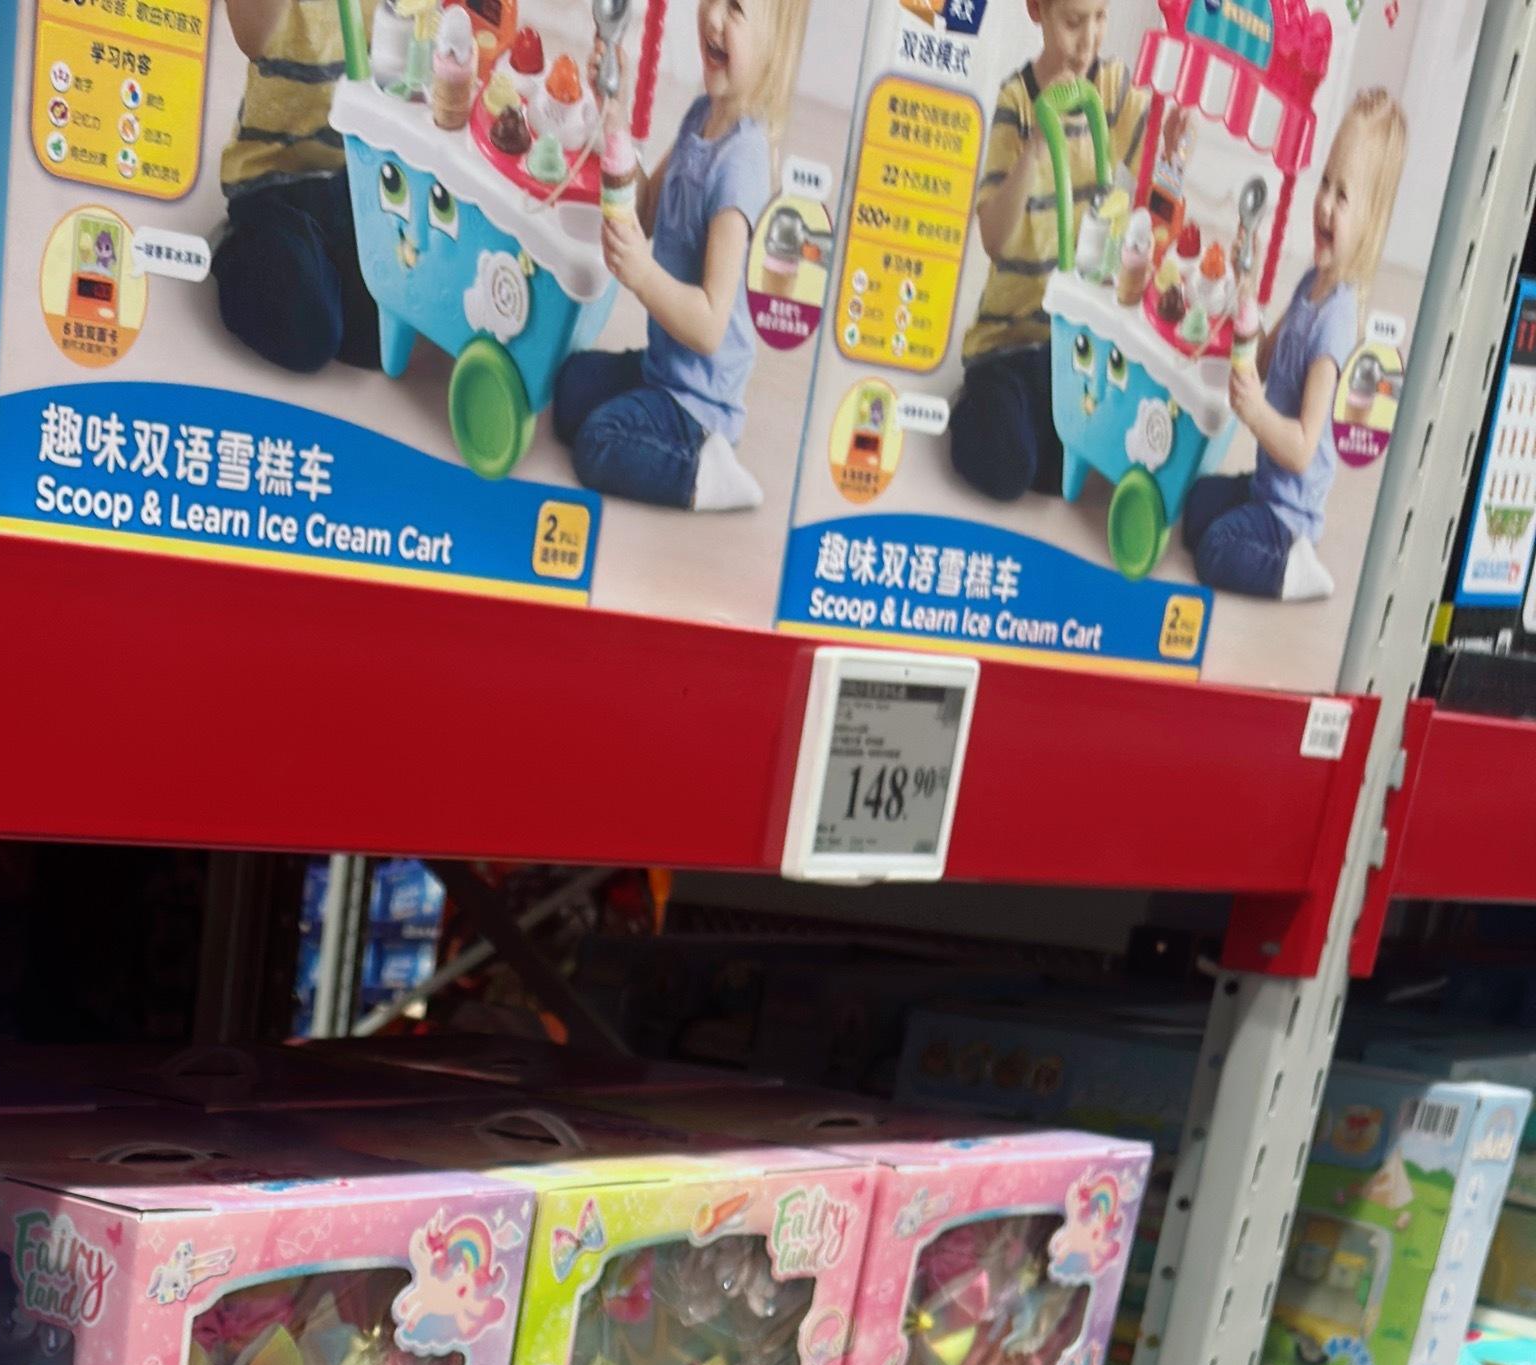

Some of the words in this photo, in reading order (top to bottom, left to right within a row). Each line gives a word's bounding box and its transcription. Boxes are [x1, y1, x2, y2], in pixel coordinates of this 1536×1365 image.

[90, 41, 152, 76] 学习内容
[39, 402, 335, 502] 趣味双语雪糕车
[37, 476, 133, 526] Scoop
[141, 497, 162, 526] &
[171, 496, 250, 538] Learn
[258, 509, 298, 544] Ice
[306, 513, 392, 558] Cream
[399, 526, 454, 565] Cart
[544, 515, 558, 544] 2
[815, 530, 1022, 603] 趣味双语雪糕车
[809, 588, 877, 627] Scoop
[880, 602, 896, 627] &
[901, 600, 957, 635] Learn
[962, 608, 991, 638] Ice
[995, 611, 1058, 646] Cream
[1063, 618, 1102, 651] Cart
[15, 1210, 114, 1322] Fairy
